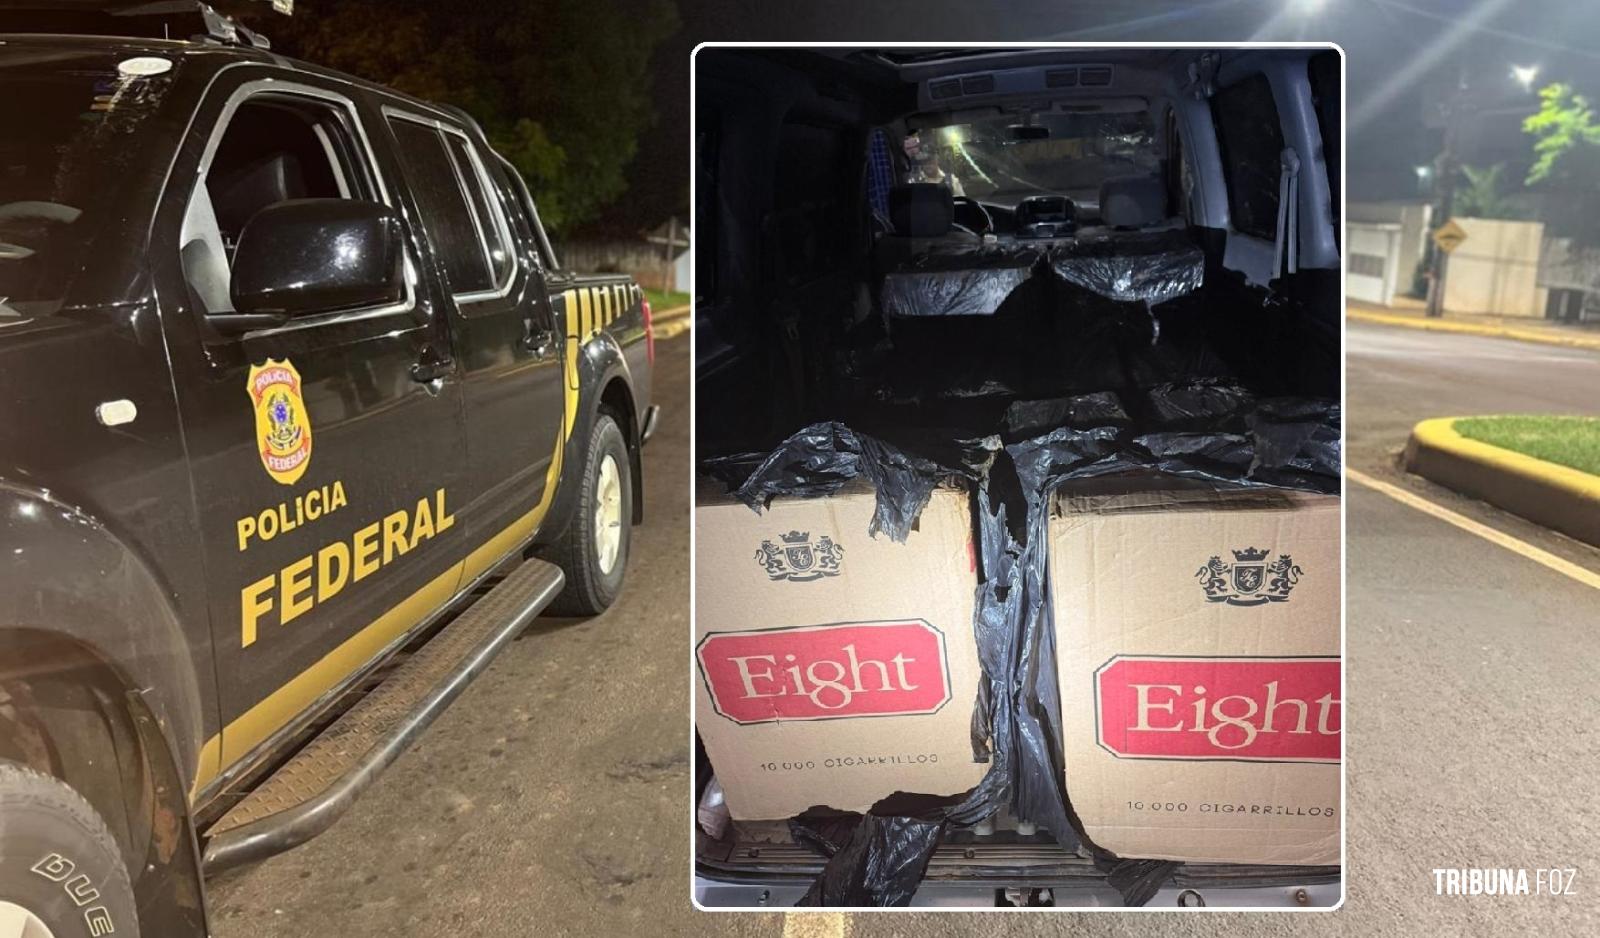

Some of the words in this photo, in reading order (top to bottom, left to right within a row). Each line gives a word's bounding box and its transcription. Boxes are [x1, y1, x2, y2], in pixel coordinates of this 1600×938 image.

[241, 488, 455, 648] FEDERAL
[727, 644, 919, 709] Eight
[1127, 680, 1341, 749] Eight
[1199, 803, 1335, 817] CIGARRILLOS
